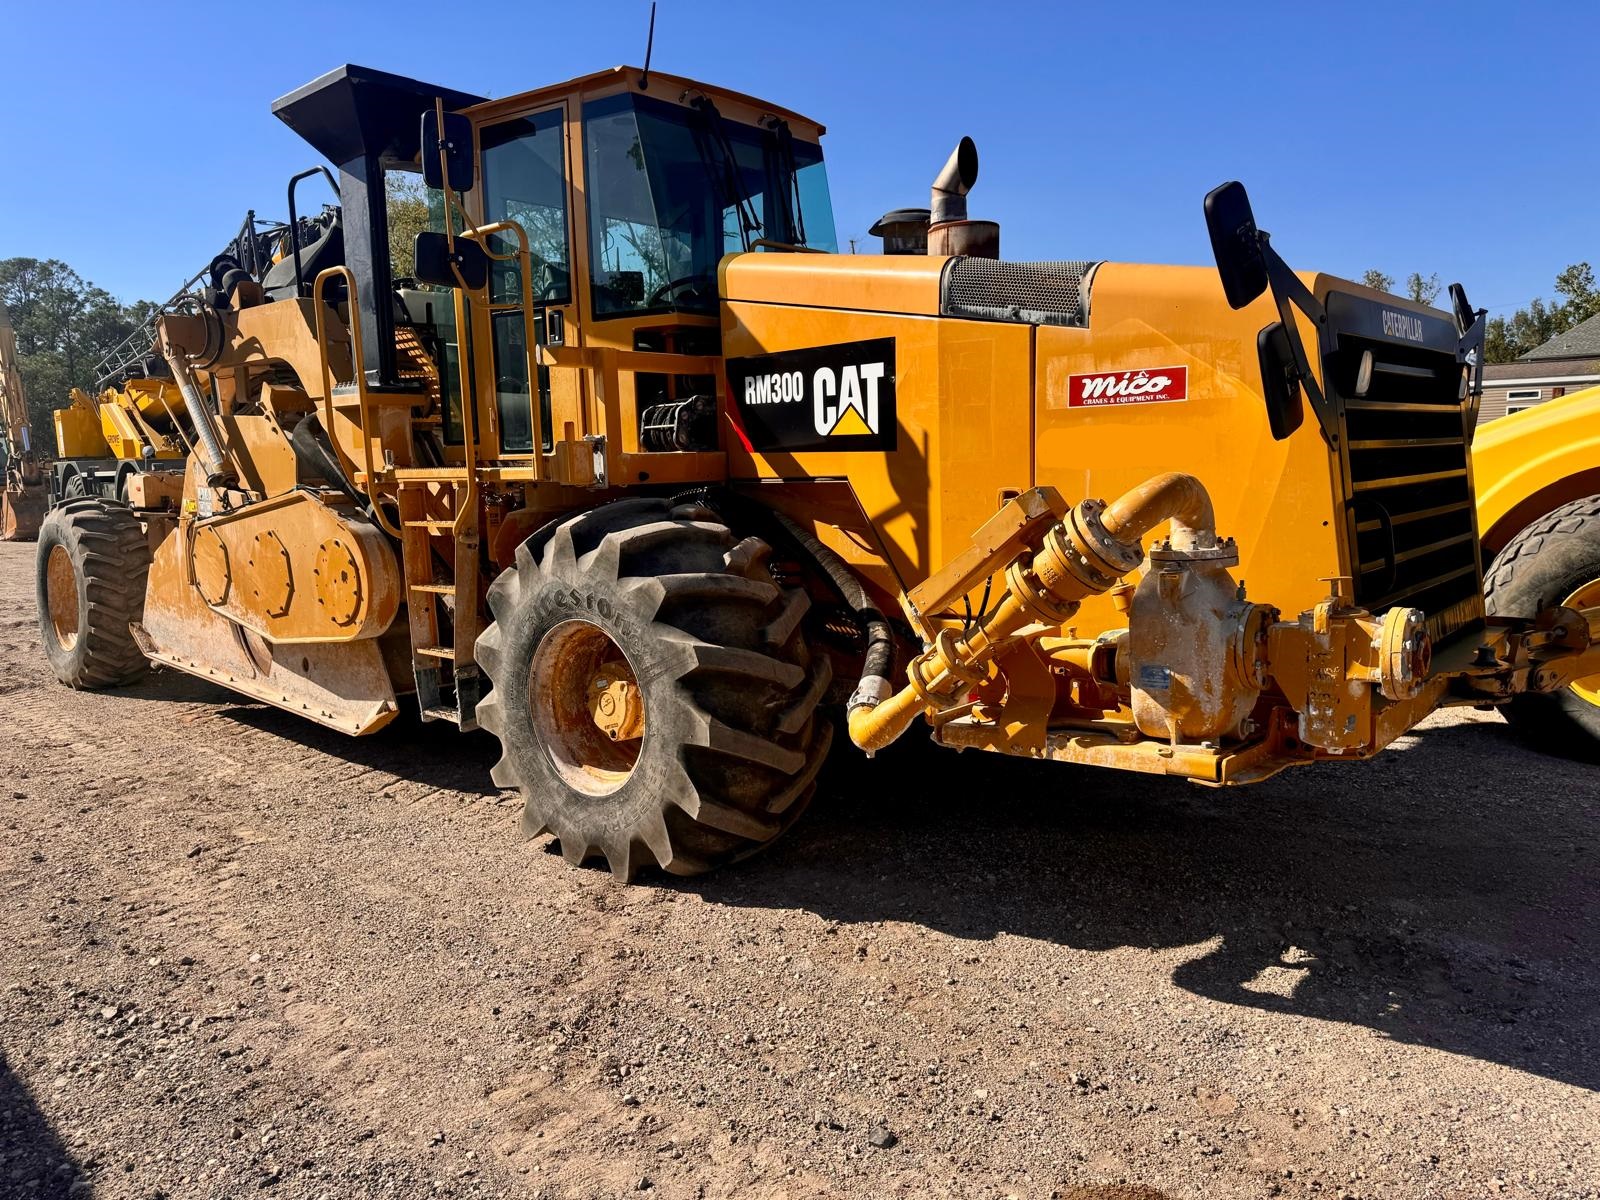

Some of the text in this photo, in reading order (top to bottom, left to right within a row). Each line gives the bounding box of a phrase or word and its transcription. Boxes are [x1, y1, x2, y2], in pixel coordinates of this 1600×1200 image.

[1382, 310, 1423, 342] CATERPILLAR
[744, 362, 885, 436] RM300 CAT
[1083, 397, 1108, 405] CRANES
[1109, 396, 1115, 404] &
[1116, 395, 1154, 403] EQUIPMENT
